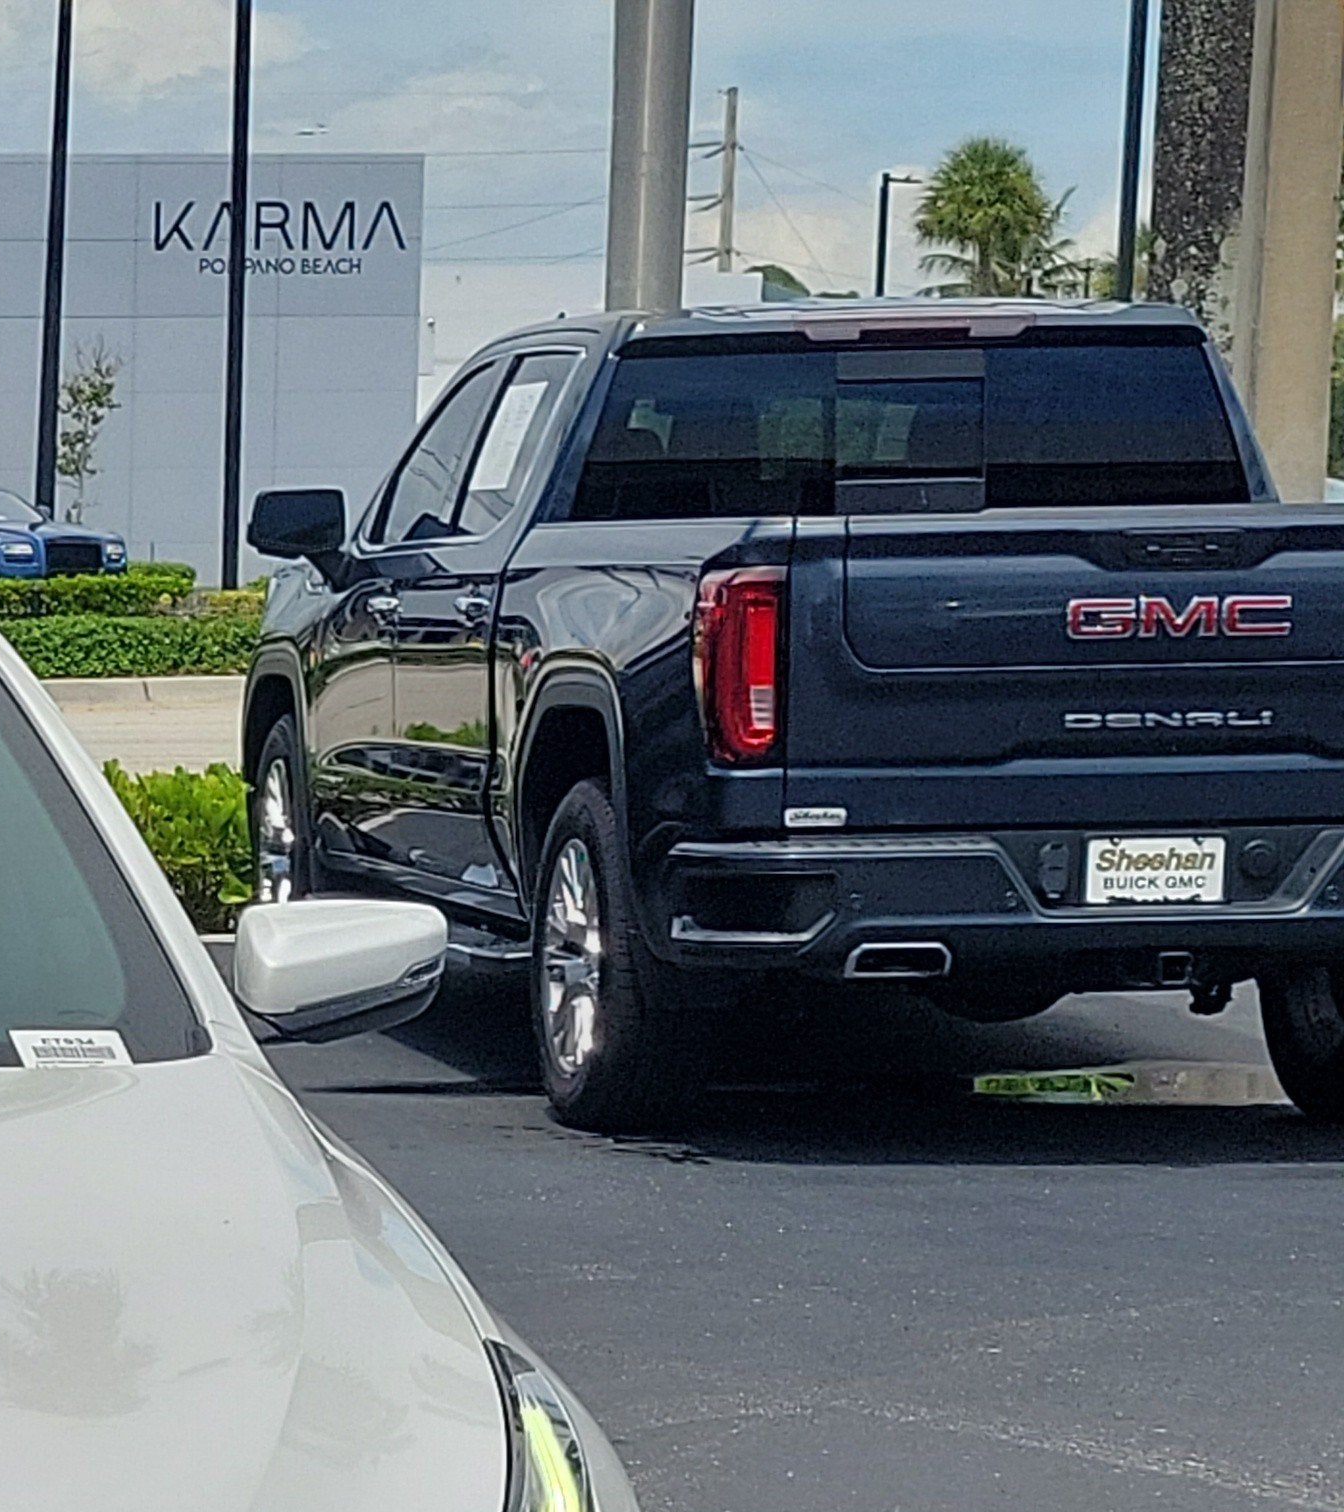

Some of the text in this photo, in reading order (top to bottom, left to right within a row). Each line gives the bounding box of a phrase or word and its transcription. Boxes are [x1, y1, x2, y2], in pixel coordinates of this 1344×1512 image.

[154, 200, 406, 251] KARMA
[199, 257, 362, 275] POPANO BEACH
[1067, 595, 1293, 640] GMC
[1064, 710, 1273, 729] DENALI
[1096, 848, 1216, 873] Sheehan
[1103, 875, 1207, 891] BUICK GMC
